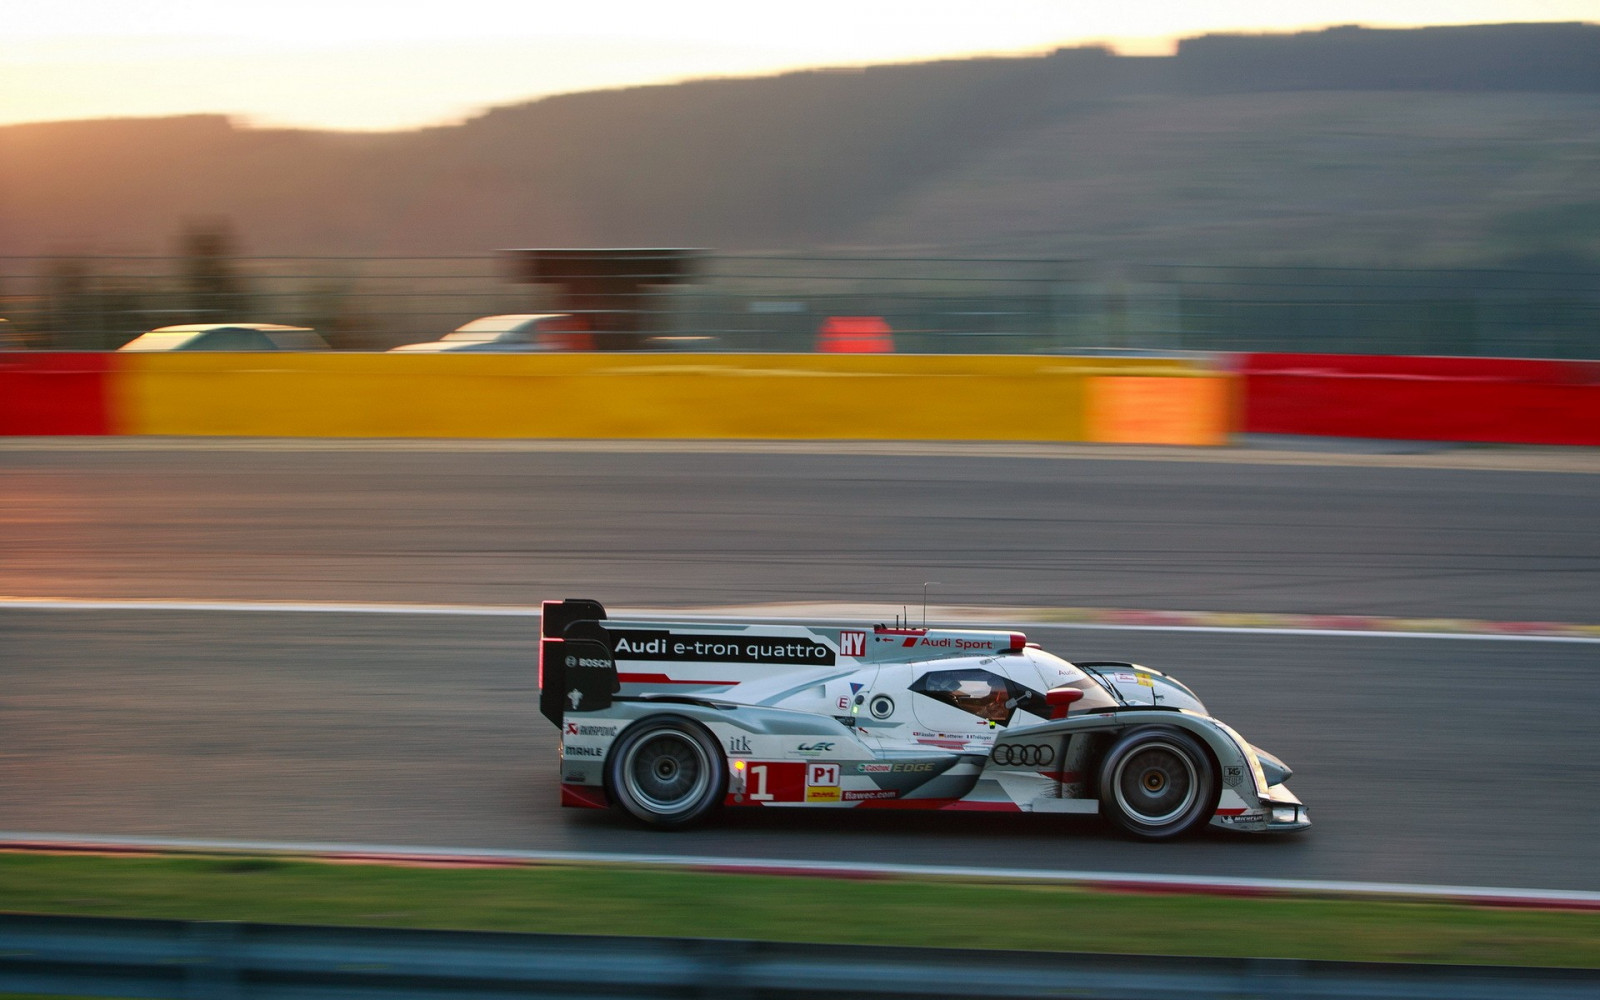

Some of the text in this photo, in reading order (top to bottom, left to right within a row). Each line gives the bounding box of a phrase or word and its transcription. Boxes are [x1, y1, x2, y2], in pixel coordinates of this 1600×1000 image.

[615, 637, 827, 659] Audi e-tron quattro
[841, 633, 864, 655] HY
[921, 638, 993, 650] Audi Sport
[579, 658, 612, 668] BOSCH
[839, 697, 848, 708] E
[730, 735, 752, 751] itk
[565, 746, 603, 757] MAHLE
[893, 763, 936, 773] EDGE
[814, 768, 834, 783] P1
[750, 765, 774, 801] 1
